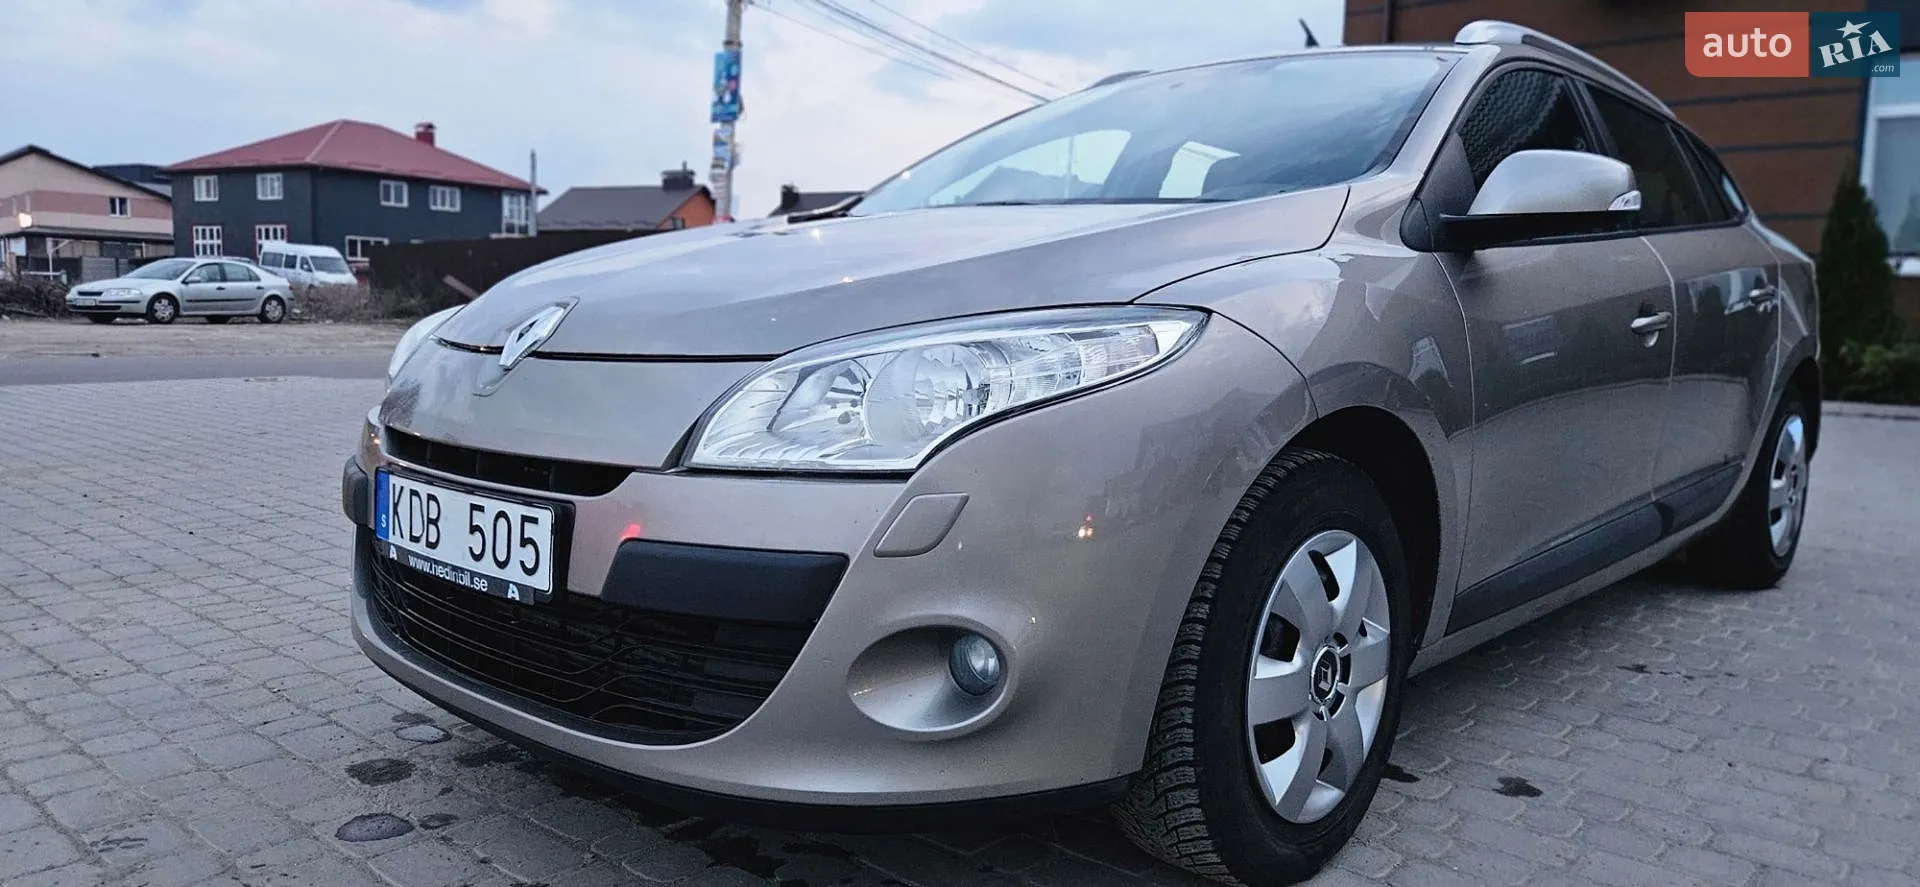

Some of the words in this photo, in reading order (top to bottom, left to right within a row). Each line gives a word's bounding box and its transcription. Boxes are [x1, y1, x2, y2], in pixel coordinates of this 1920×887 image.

[380, 514, 387, 528] S
[391, 483, 441, 550] KDB
[468, 502, 540, 577] 505
